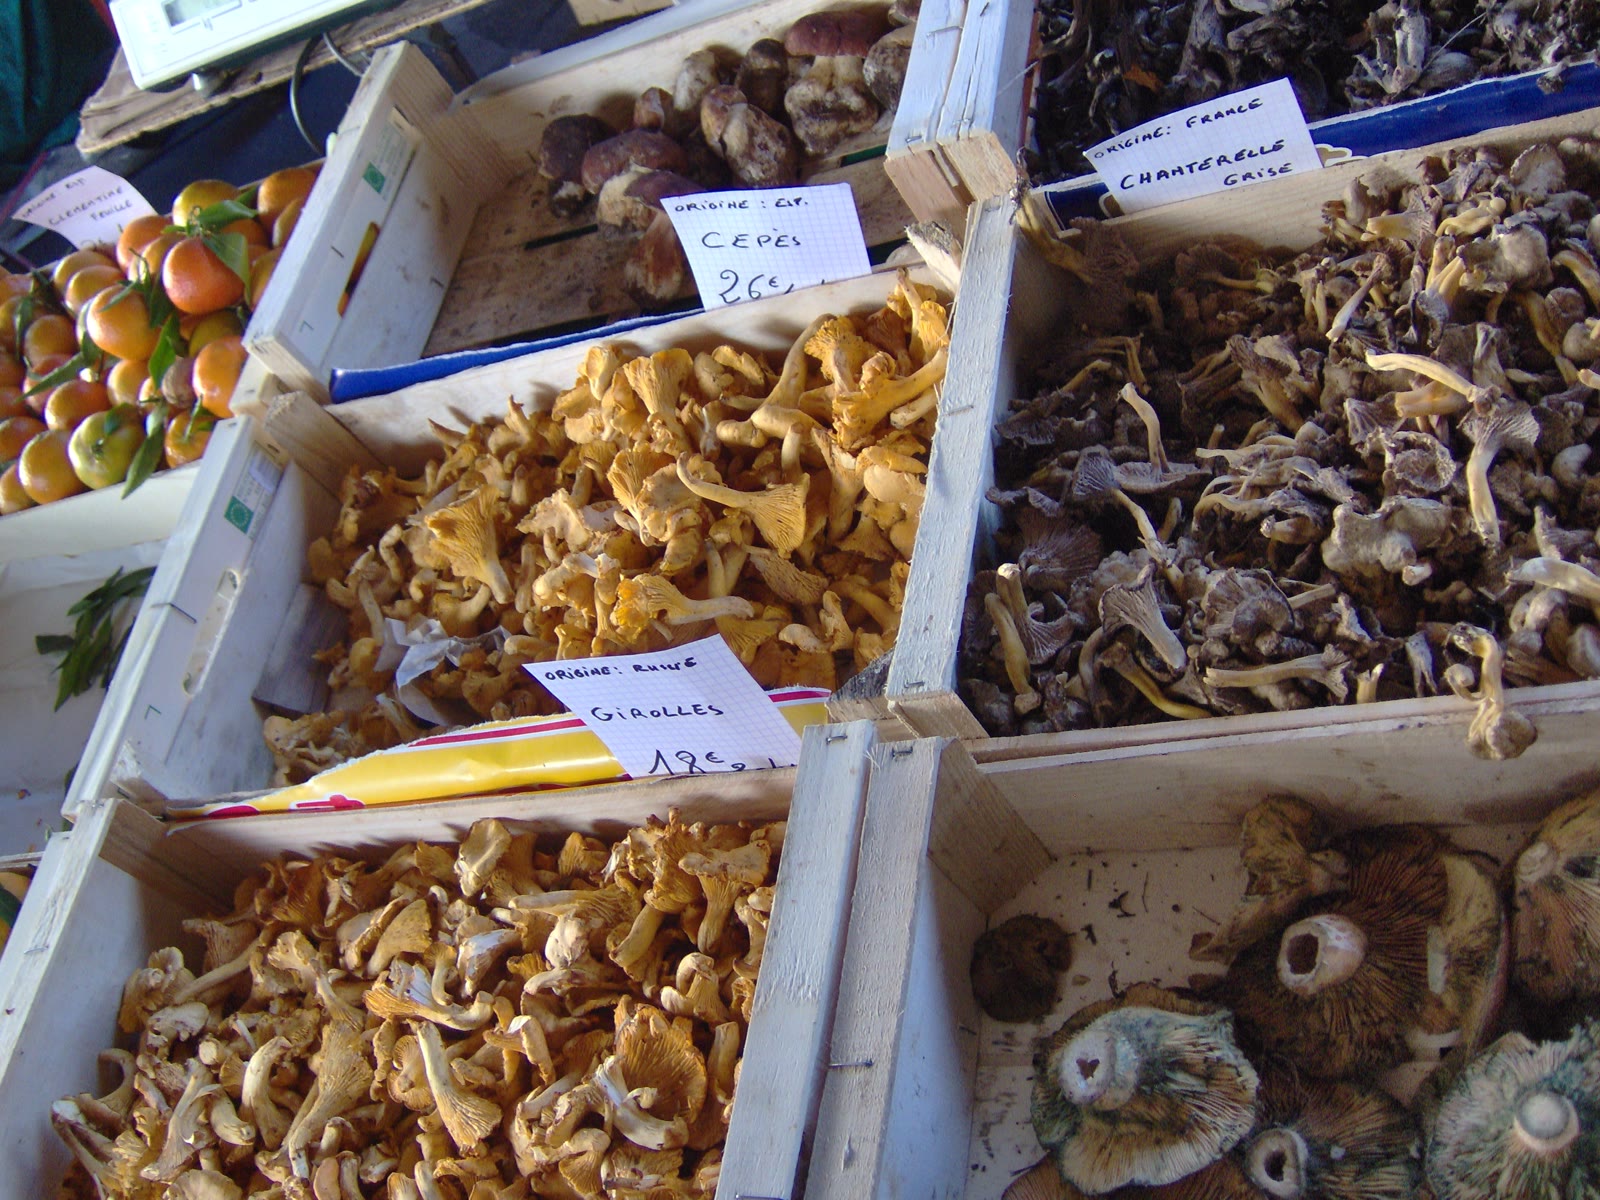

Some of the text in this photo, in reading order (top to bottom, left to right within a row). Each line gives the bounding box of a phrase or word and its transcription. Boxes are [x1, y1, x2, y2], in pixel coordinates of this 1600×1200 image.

[1186, 98, 1264, 129] FRANCE
[1120, 139, 1285, 190] CHANTERELLE
[1223, 162, 1293, 187] GRISE
[48, 187, 123, 226] CLEMENTINE
[591, 704, 724, 723] GIROLLES
